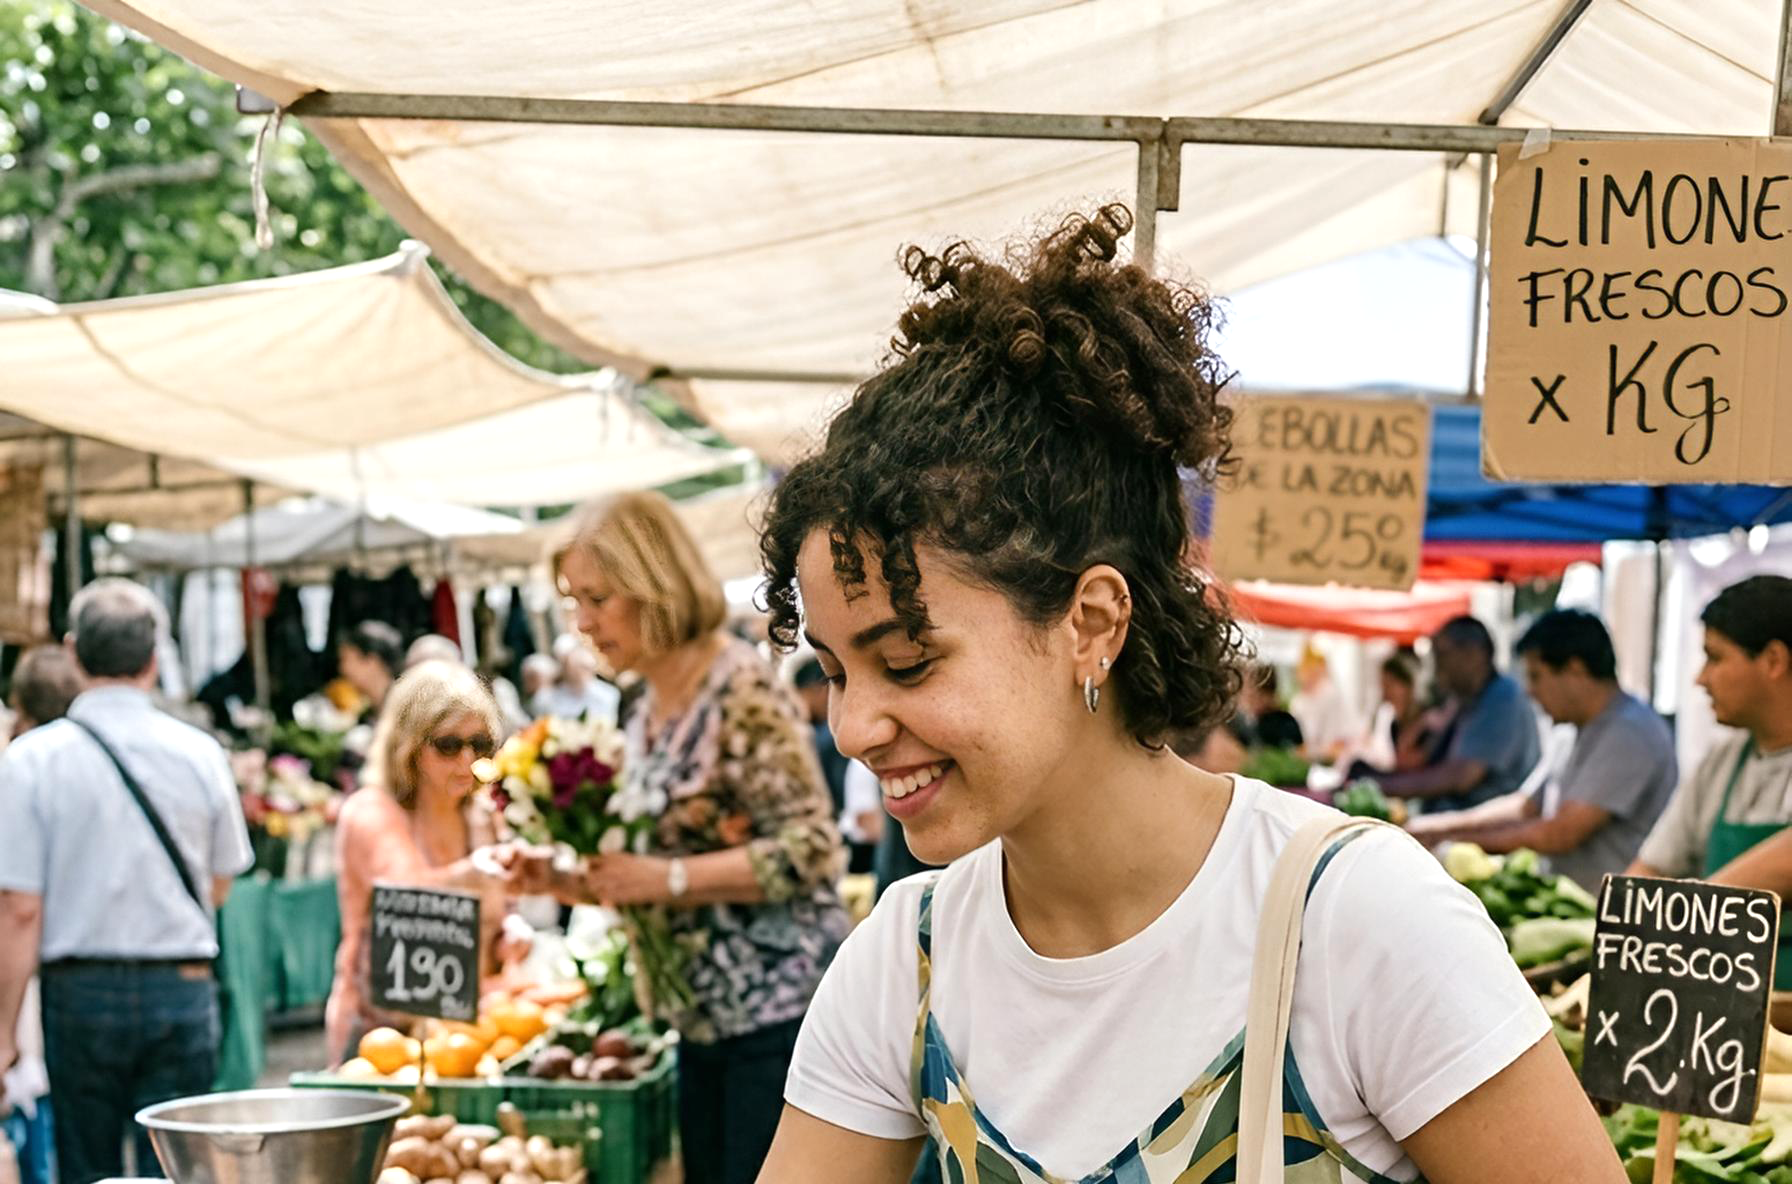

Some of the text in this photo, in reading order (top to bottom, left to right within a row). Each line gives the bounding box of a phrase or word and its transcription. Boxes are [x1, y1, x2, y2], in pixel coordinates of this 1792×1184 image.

[1525, 158, 1792, 249] LiMONE
[1518, 267, 1788, 327] FRESCOS
[1528, 340, 1730, 465] x KG
[1238, 405, 1419, 460] EBOLLAS
[1281, 463, 1319, 492] LA
[1328, 465, 1417, 501] ZONA
[1597, 933, 1760, 992] FRESCOS
[1594, 1010, 1620, 1047] x
